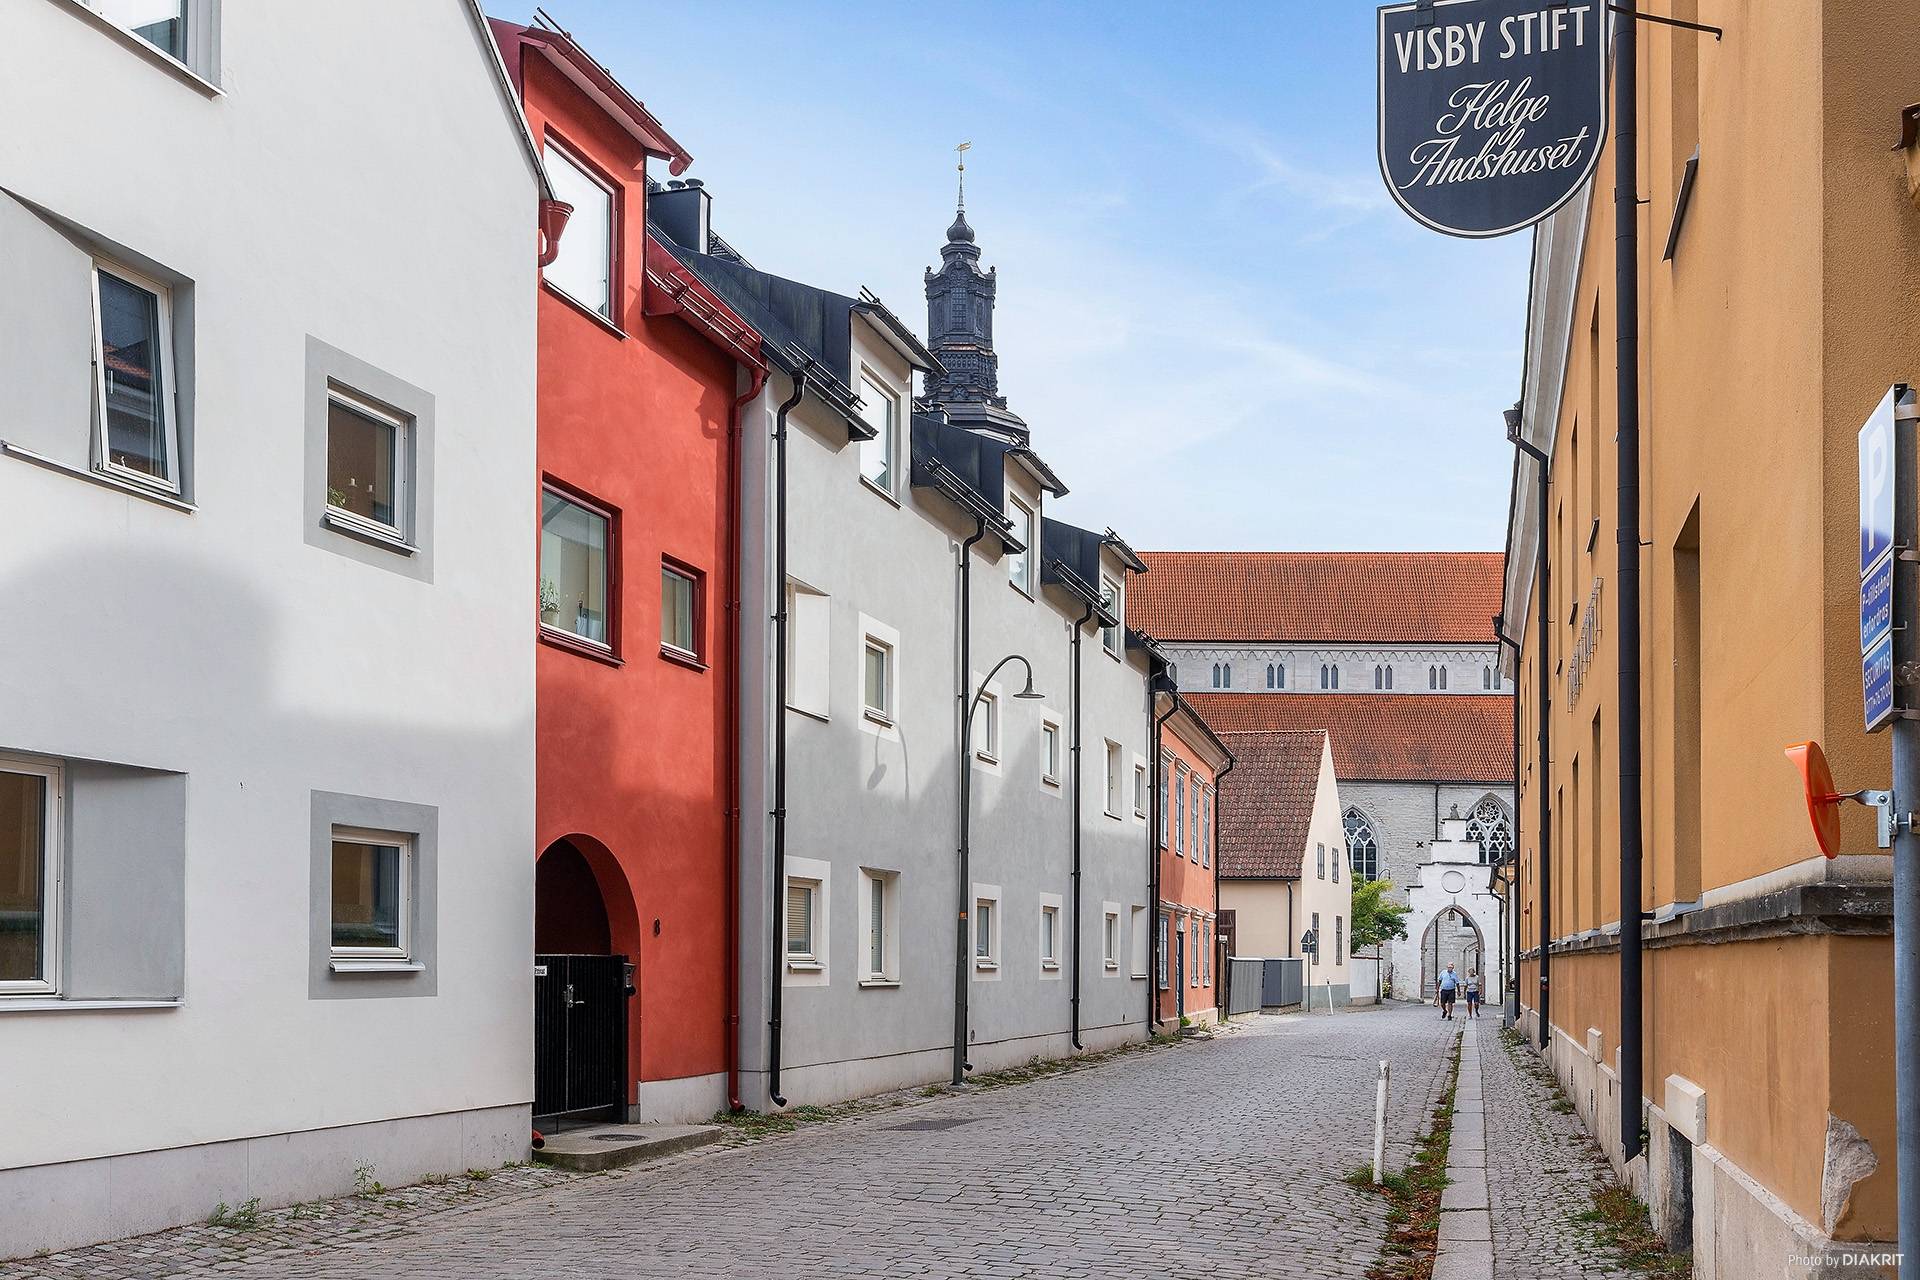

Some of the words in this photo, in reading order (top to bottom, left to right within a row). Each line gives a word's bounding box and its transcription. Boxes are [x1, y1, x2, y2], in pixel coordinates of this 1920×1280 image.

[1394, 21, 1486, 74] VISBY
[1499, 6, 1591, 60] STIFT
[1436, 76, 1550, 146] Helge
[1398, 126, 1590, 189] Andshuset
[1868, 424, 1888, 553] P
[1865, 651, 1890, 690] SECURITAS
